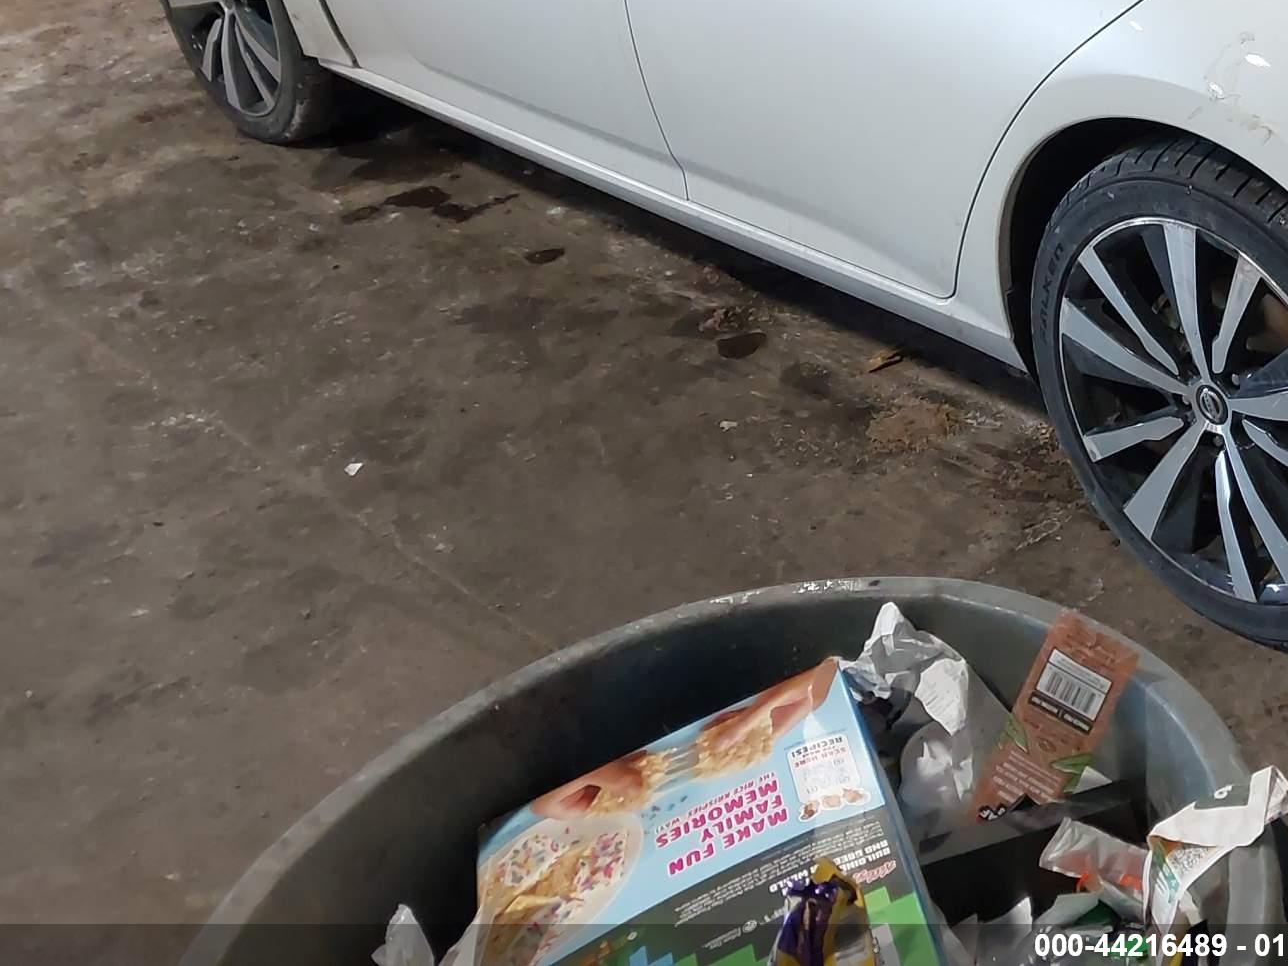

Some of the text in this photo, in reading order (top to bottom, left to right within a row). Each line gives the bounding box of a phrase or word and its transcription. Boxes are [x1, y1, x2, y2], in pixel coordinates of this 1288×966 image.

[791, 736, 843, 758] RECIPES!
[733, 780, 754, 795] RICE
[656, 779, 778, 848] MEMORIES
[701, 794, 782, 843] FAMILY
[723, 808, 788, 849] MAKE
[668, 843, 715, 875] FUN
